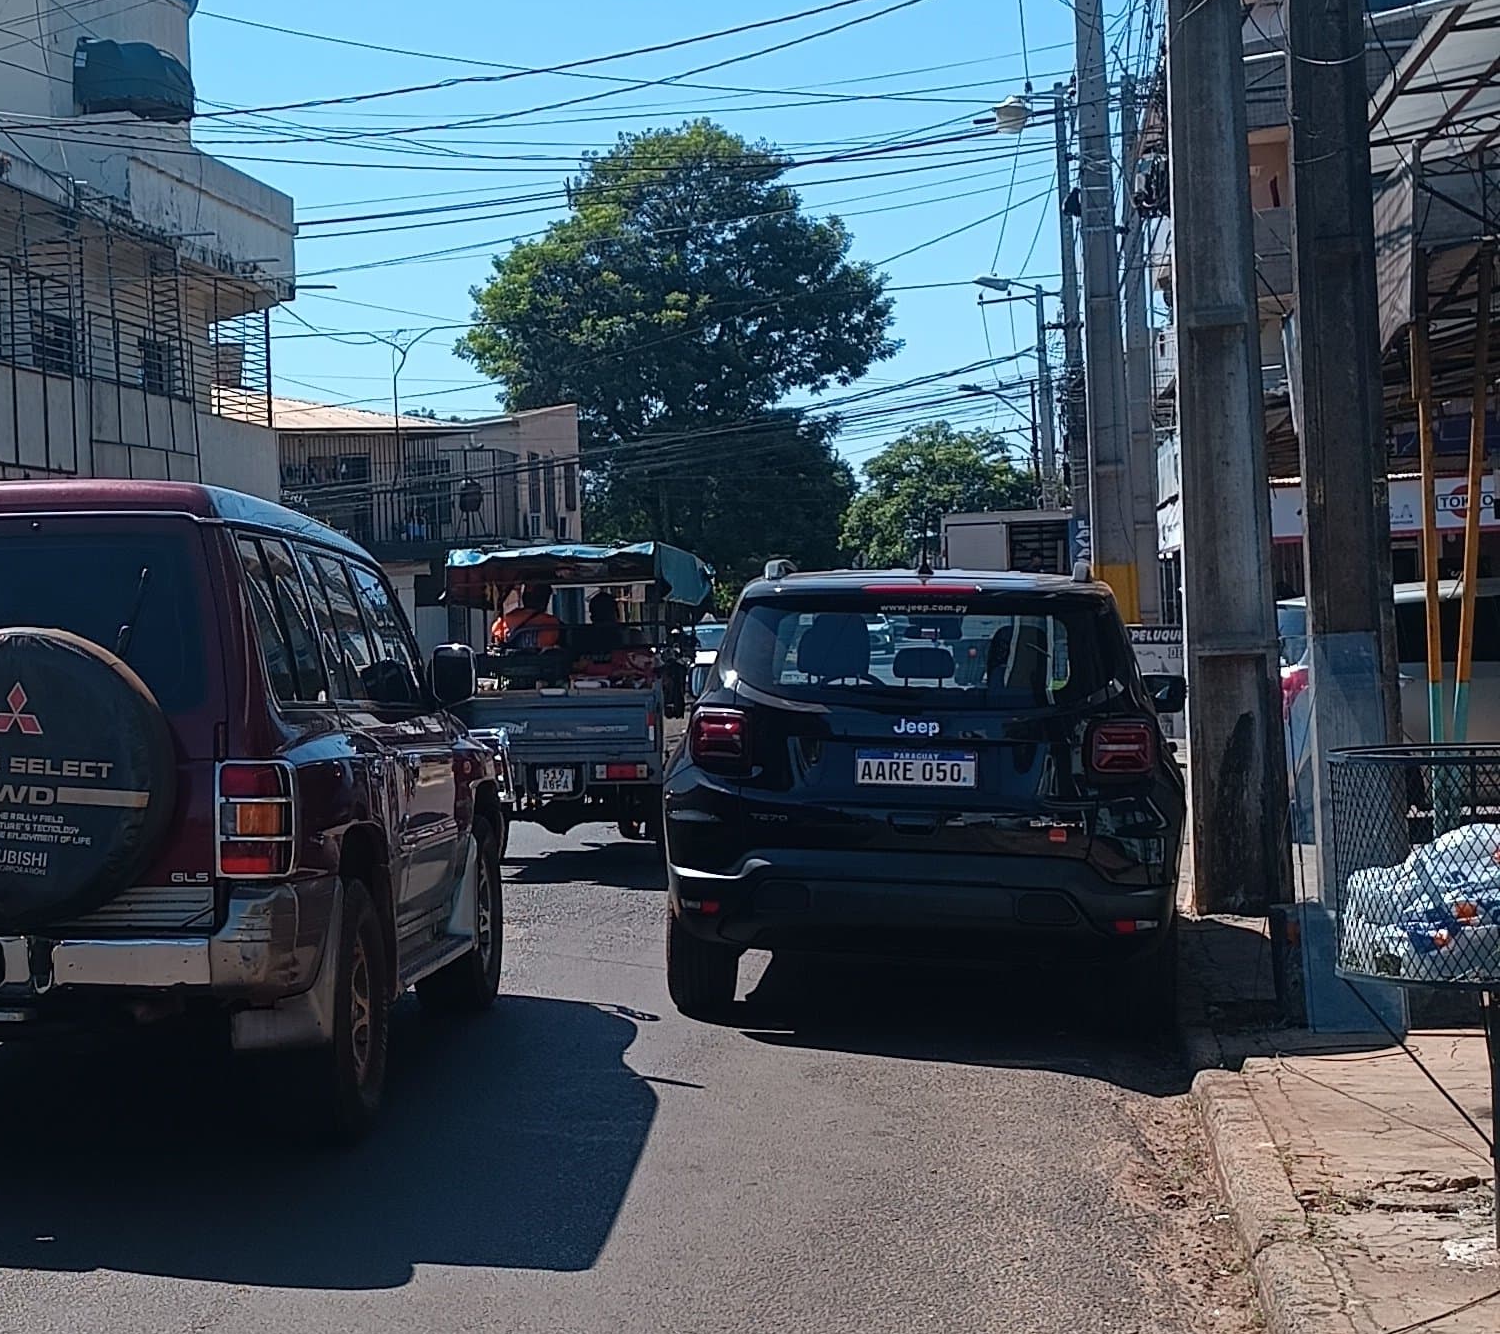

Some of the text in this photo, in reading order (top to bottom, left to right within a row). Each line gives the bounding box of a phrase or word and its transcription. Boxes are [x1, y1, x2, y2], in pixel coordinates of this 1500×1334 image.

[880, 604, 967, 613] www.jeep.com.py
[893, 718, 940, 737] Jeep
[894, 752, 940, 761] PARAGUAY
[10, 757, 113, 778] SELECT
[861, 761, 961, 783] AARE 050
[10, 813, 38, 823] RALLY
[39, 814, 64, 824] FIELD
[60, 835, 71, 844] OF
[72, 836, 92, 846] LIFE
[171, 872, 209, 883] GLS
